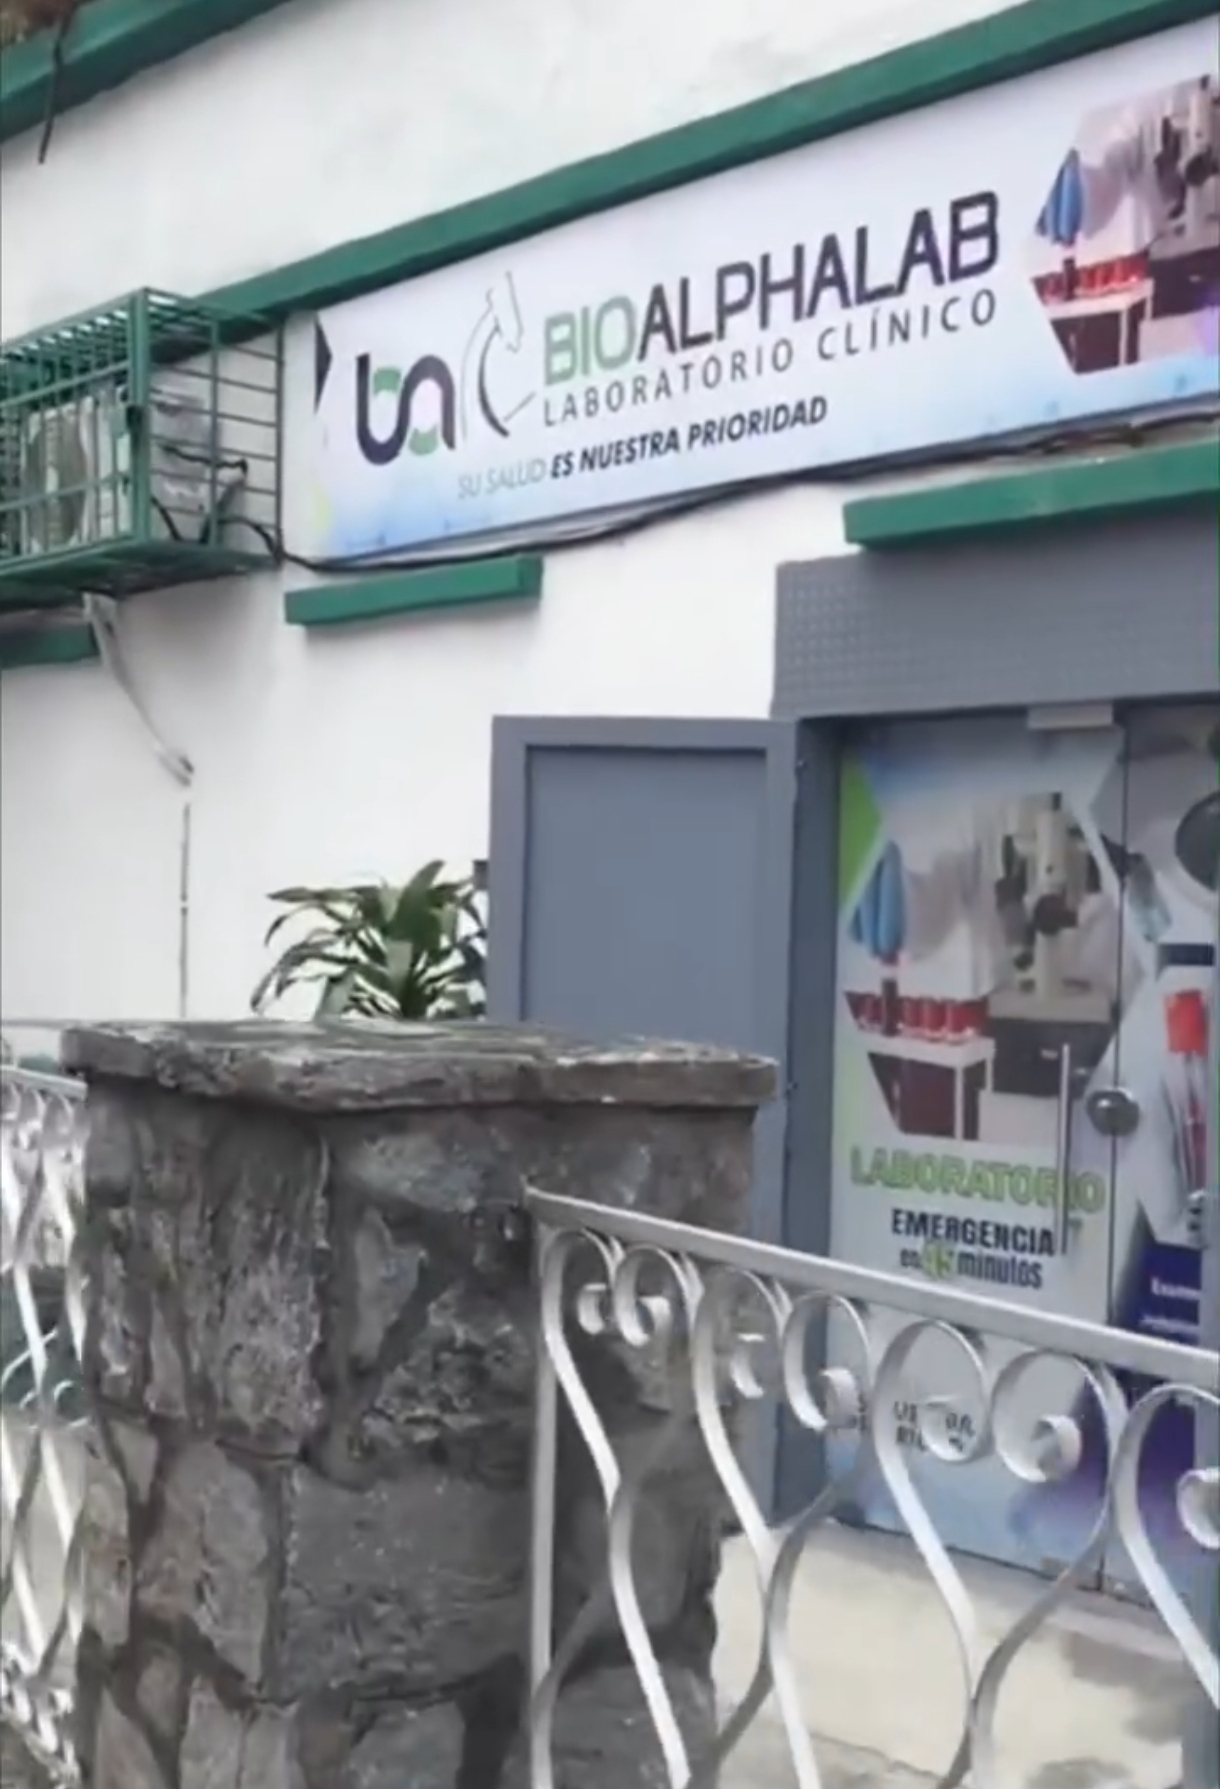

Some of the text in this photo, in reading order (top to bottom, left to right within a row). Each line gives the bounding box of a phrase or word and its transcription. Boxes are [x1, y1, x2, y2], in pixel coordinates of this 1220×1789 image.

[543, 190, 1000, 386] BIOALPHALAB
[543, 287, 997, 428] LABORATORIO CLÍNICO
[457, 395, 829, 499] SU SALUD ES NUESTRA PRIORIDAD
[891, 1207, 1056, 1258] EMERGENCIA
[957, 1250, 1043, 1289] minutos
